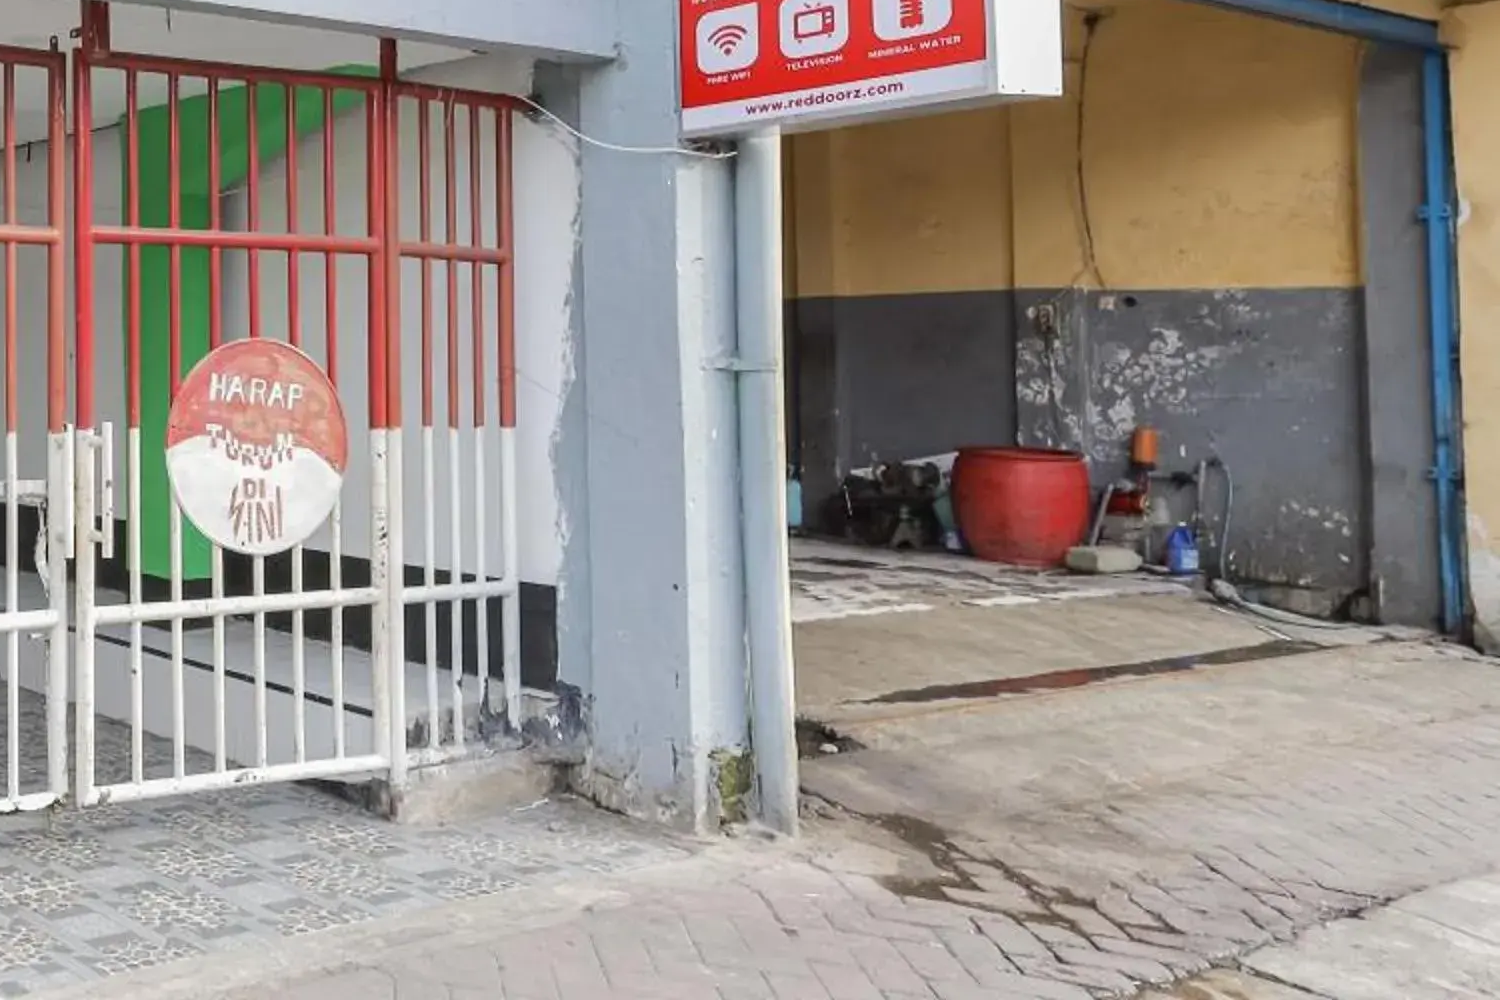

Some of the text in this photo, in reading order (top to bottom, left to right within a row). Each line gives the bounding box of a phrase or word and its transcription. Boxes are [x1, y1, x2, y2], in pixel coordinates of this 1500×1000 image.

[867, 34, 961, 60] MINERAL WATER
[785, 53, 843, 72] TELEVISION
[745, 81, 904, 116] www.reddoorz.com
[209, 372, 303, 410] HARAP
[205, 423, 295, 470] TURUN
[242, 478, 266, 499] DI
